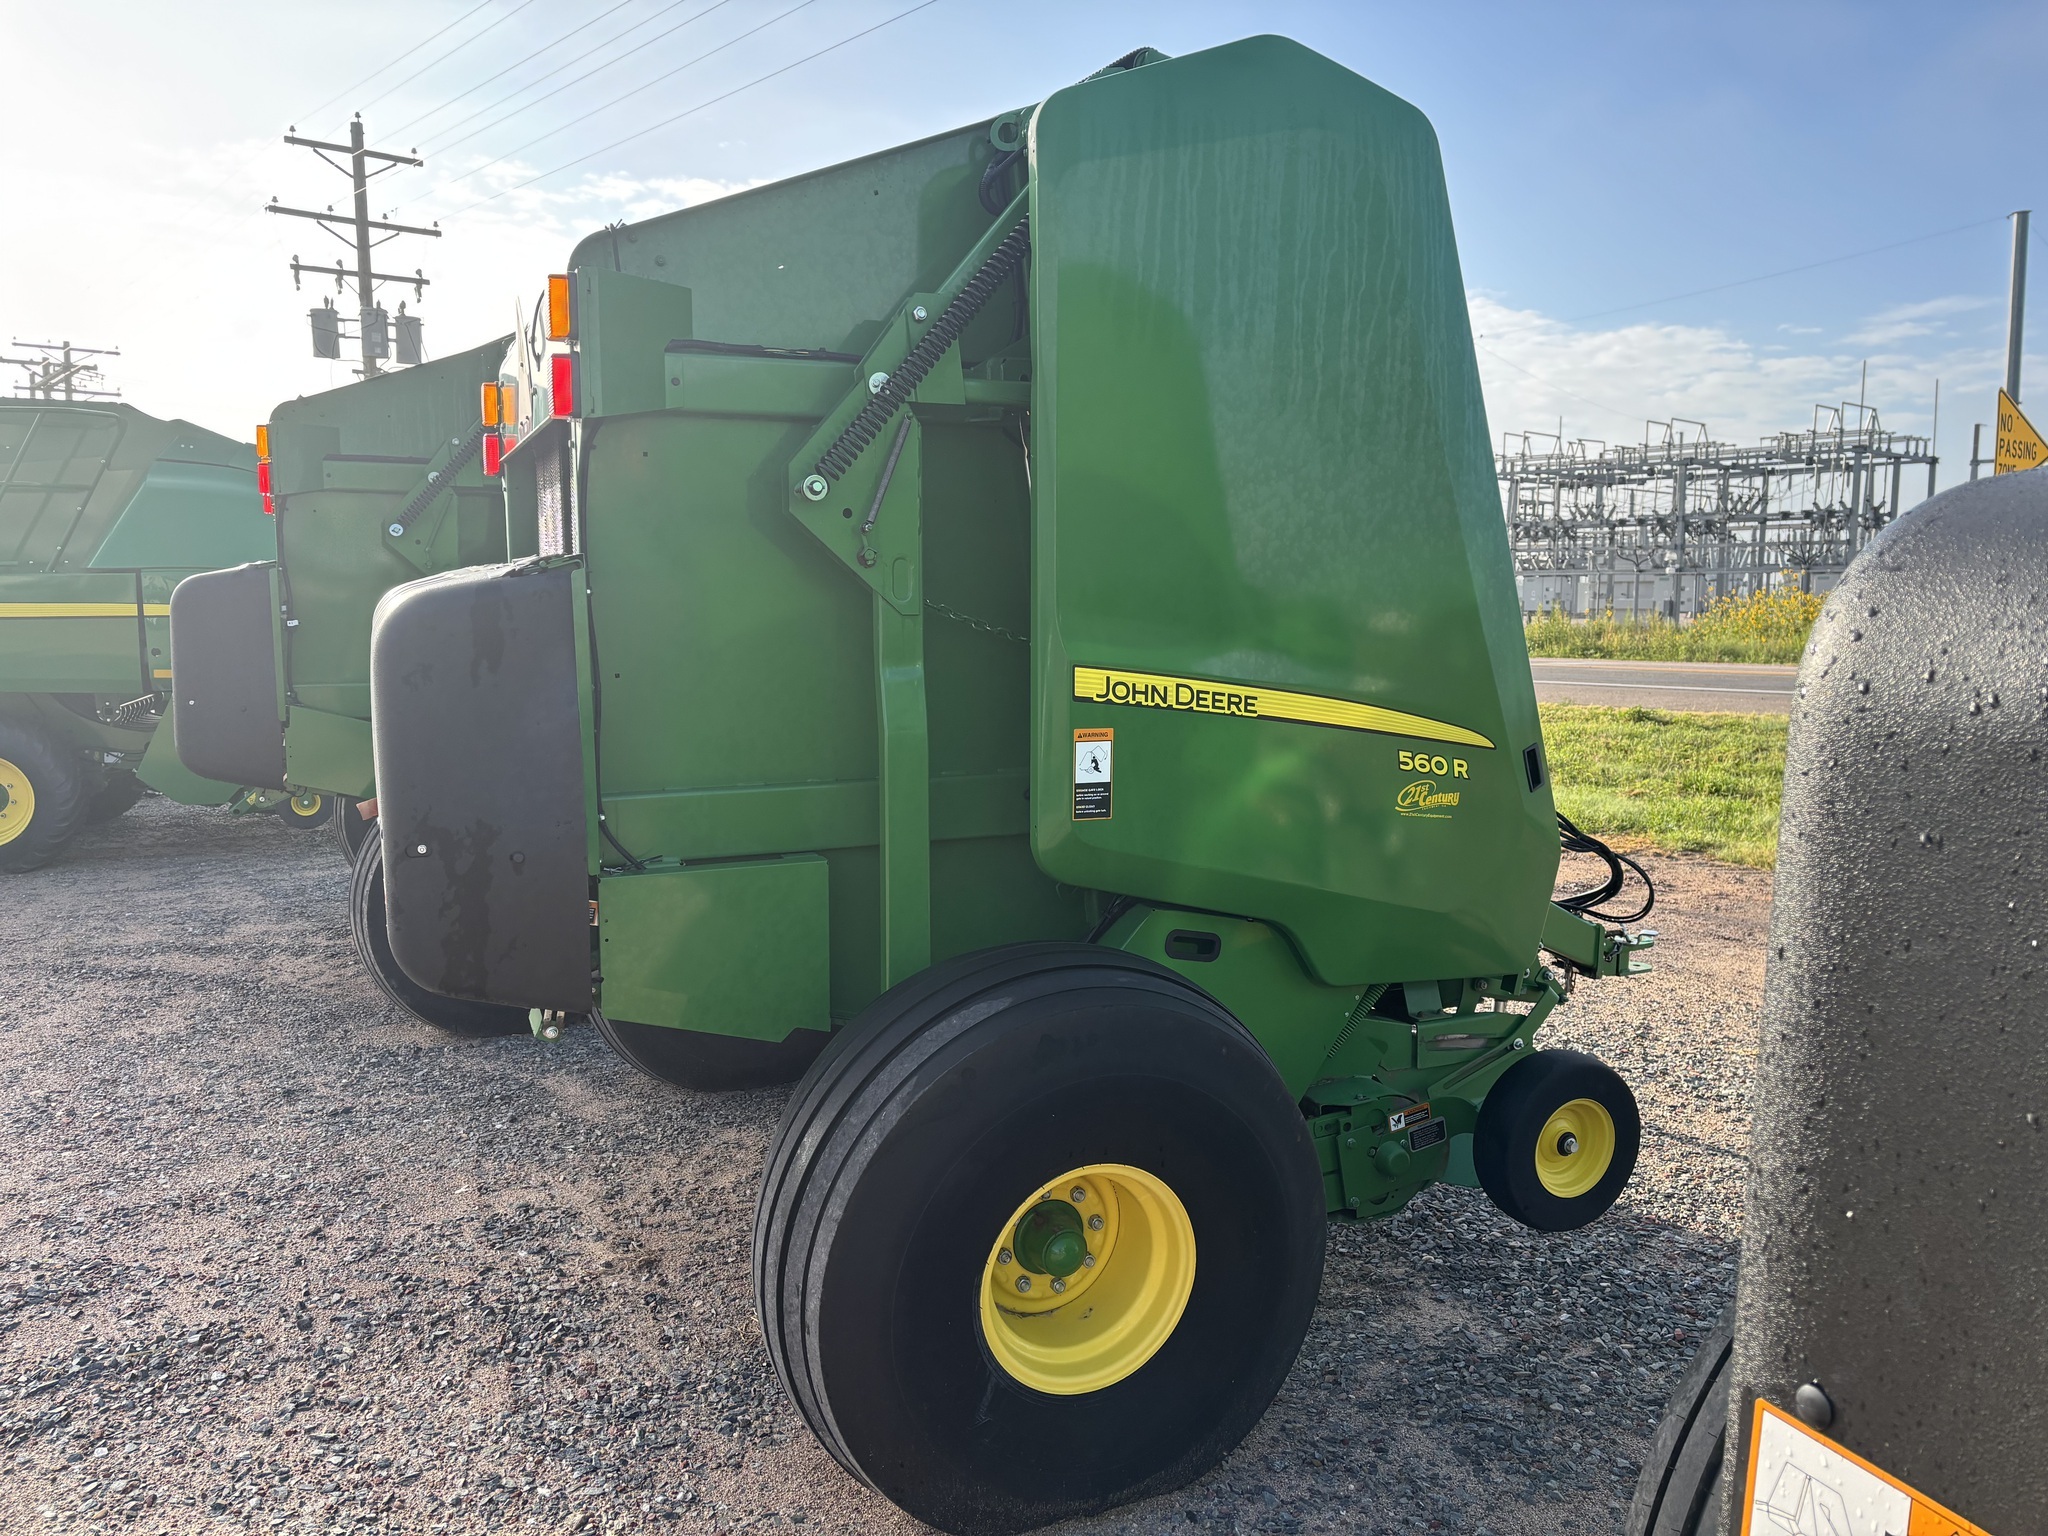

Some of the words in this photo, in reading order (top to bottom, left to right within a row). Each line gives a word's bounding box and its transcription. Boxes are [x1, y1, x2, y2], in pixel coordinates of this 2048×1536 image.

[2000, 413, 2013, 433] NO
[1998, 438, 2037, 461] PASSING
[1095, 675, 1168, 705] JOHN
[1175, 682, 1258, 715] DEERE
[1398, 750, 1449, 776] 560
[1453, 758, 1470, 779] R
